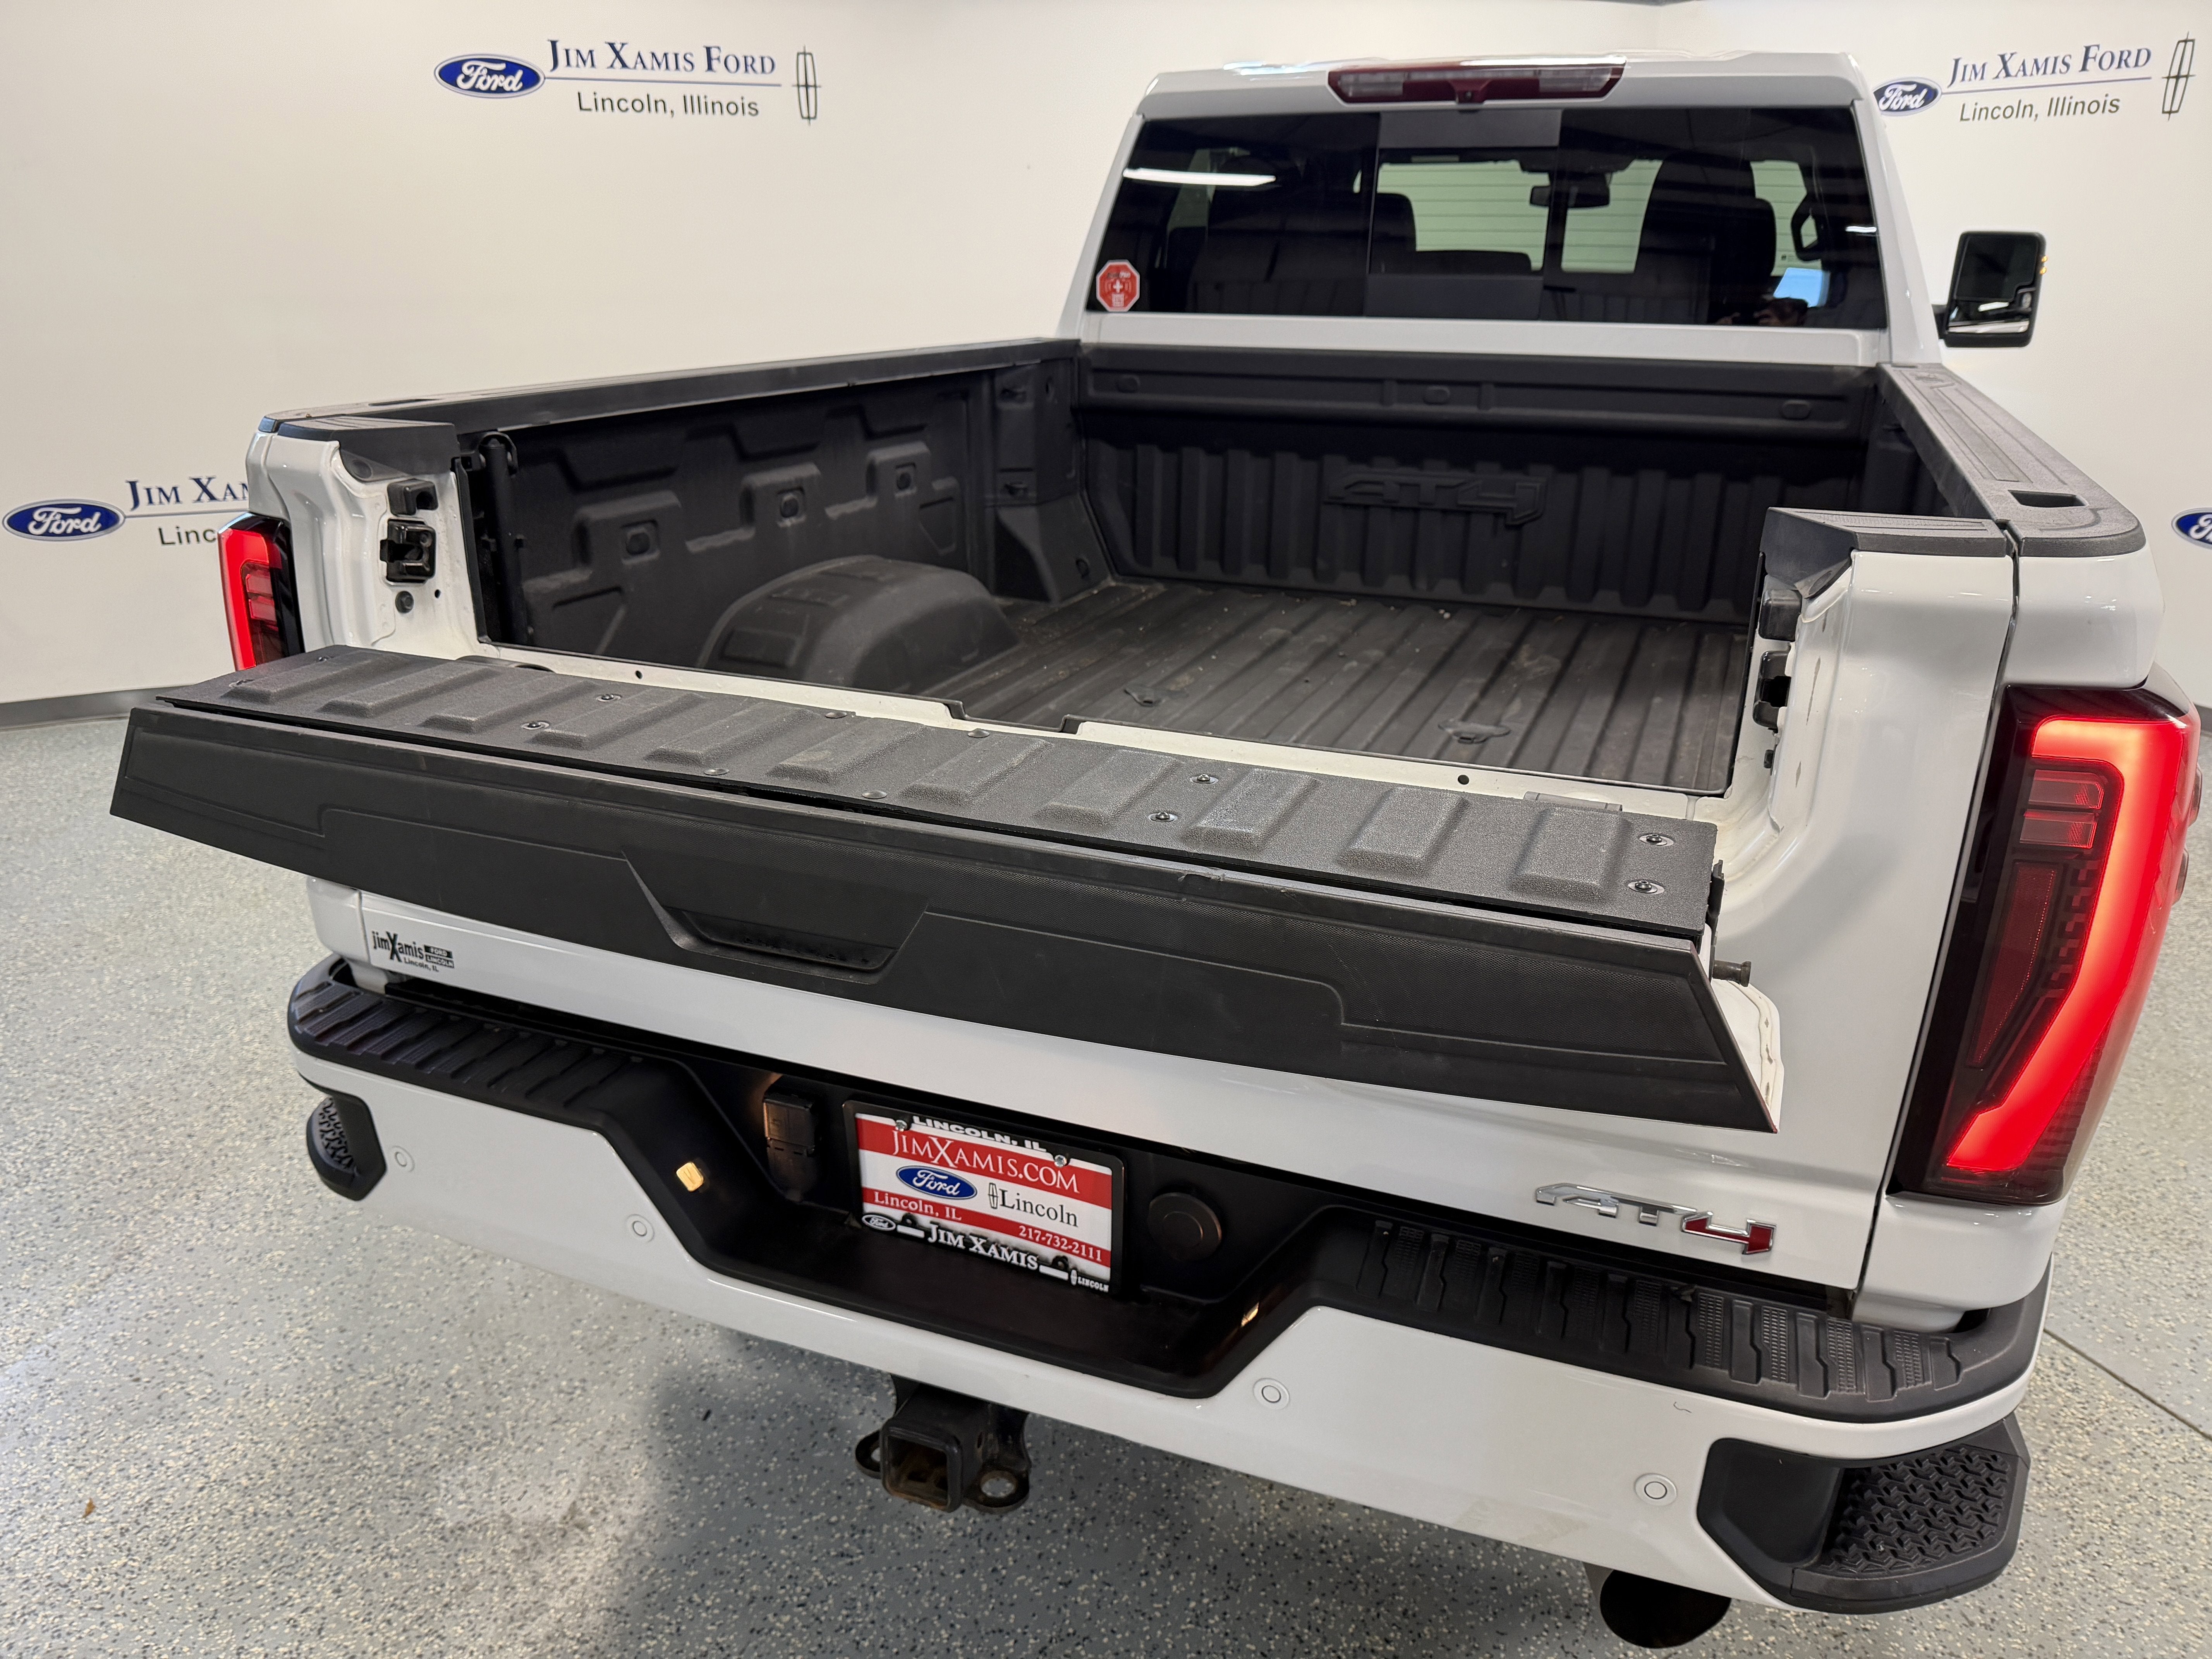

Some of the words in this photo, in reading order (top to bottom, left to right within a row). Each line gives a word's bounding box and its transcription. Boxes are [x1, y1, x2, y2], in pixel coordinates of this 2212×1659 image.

[548, 39, 596, 72] JIM
[605, 41, 696, 72] XAMIS
[703, 45, 776, 75] FORD
[1947, 57, 1988, 88] JIM
[1993, 51, 2071, 79] XAMIS
[2080, 44, 2152, 72] FORD
[456, 60, 523, 93] Ford
[577, 91, 675, 117] Lincoln,
[683, 94, 759, 116] Illinois
[1879, 84, 1928, 110] Ford
[1960, 99, 2038, 122] Lincoln,
[2047, 93, 2120, 117] Illinois
[125, 479, 182, 512] JIM
[28, 507, 101, 535] Ford
[427, 955, 453, 967] LINCOLN
[431, 947, 448, 957] FORD
[1024, 1140, 1047, 1152] IL
[912, 1170, 961, 1196] Ford
[874, 1191, 939, 1216] Lincoln,
[945, 1206, 962, 1220] IL
[999, 1188, 1079, 1228] Lincoln
[1535, 1182, 1777, 1255] AT4
[870, 1217, 889, 1228] Ford
[927, 1224, 965, 1249] JIM
[969, 1235, 1039, 1270] XAMIS
[1019, 1225, 1102, 1262] 217-732-2111
[1078, 1276, 1109, 1293] LINCOLN
